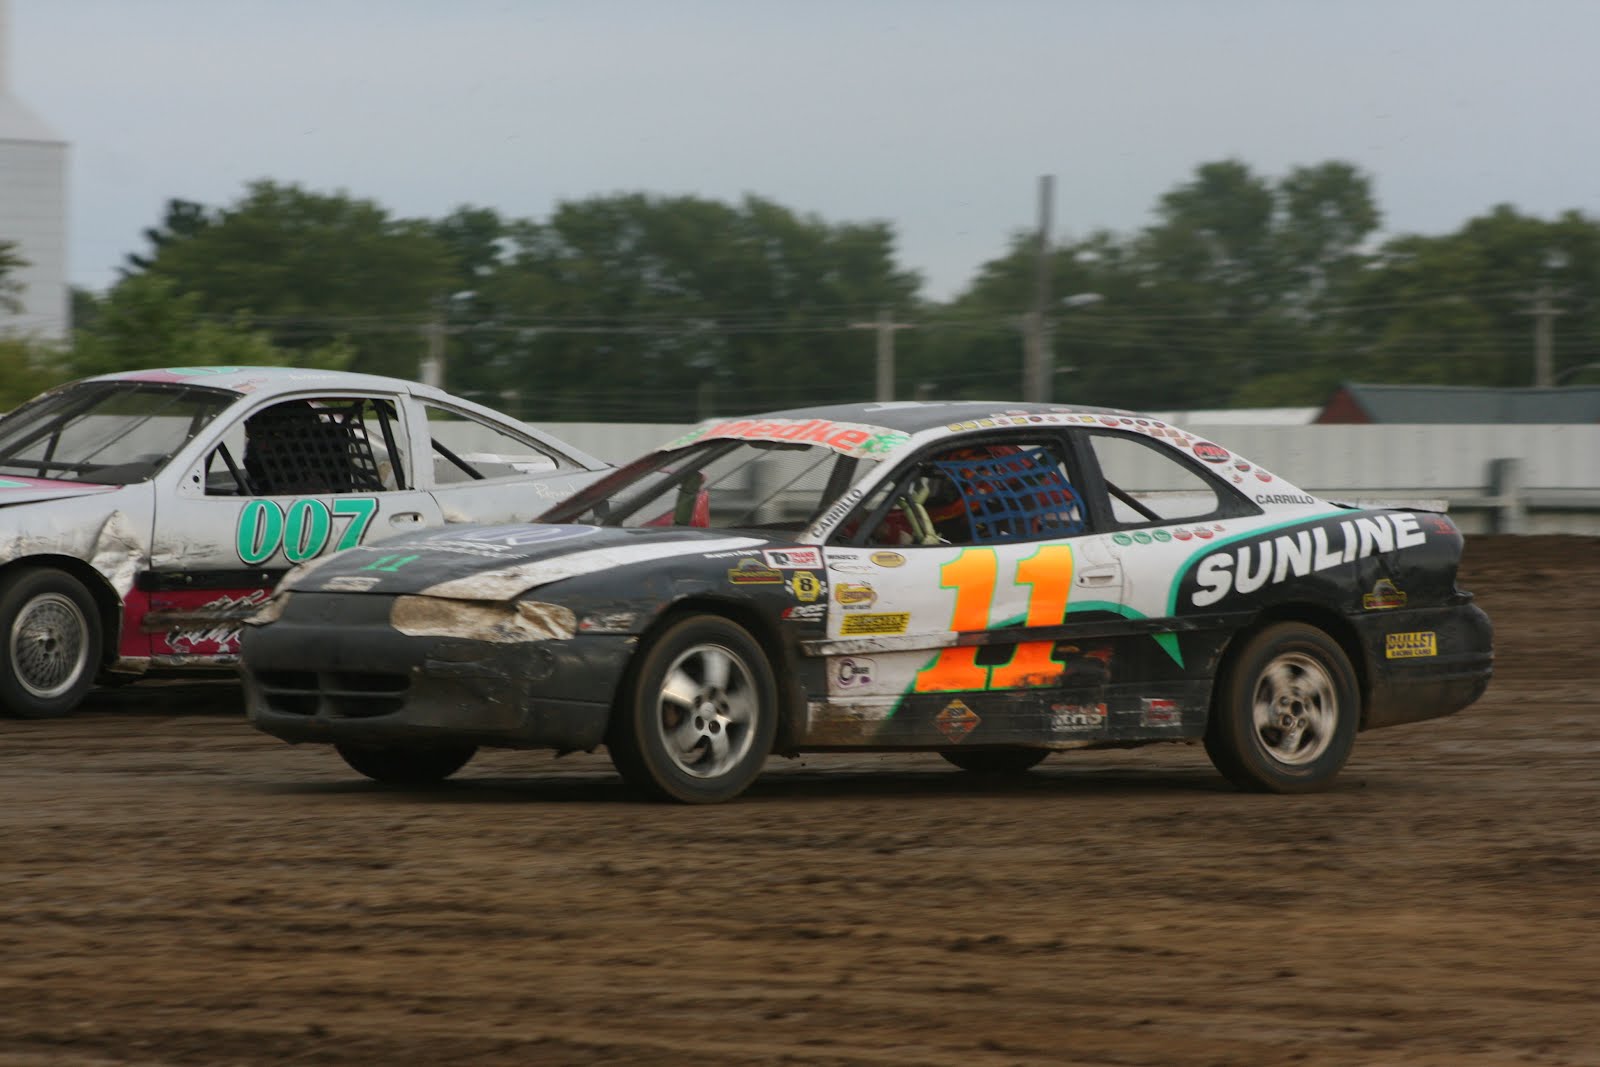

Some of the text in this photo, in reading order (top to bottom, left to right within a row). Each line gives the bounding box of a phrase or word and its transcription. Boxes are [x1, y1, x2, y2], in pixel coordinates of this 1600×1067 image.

[811, 488, 864, 539] CARRILLO
[1255, 493, 1316, 506] CARRILLO
[236, 497, 379, 566] 007
[360, 554, 421, 573] 11
[1191, 512, 1427, 608] SUNLINE
[800, 578, 814, 592] 8
[914, 543, 1074, 694] 11
[1387, 633, 1434, 650] BULLET
